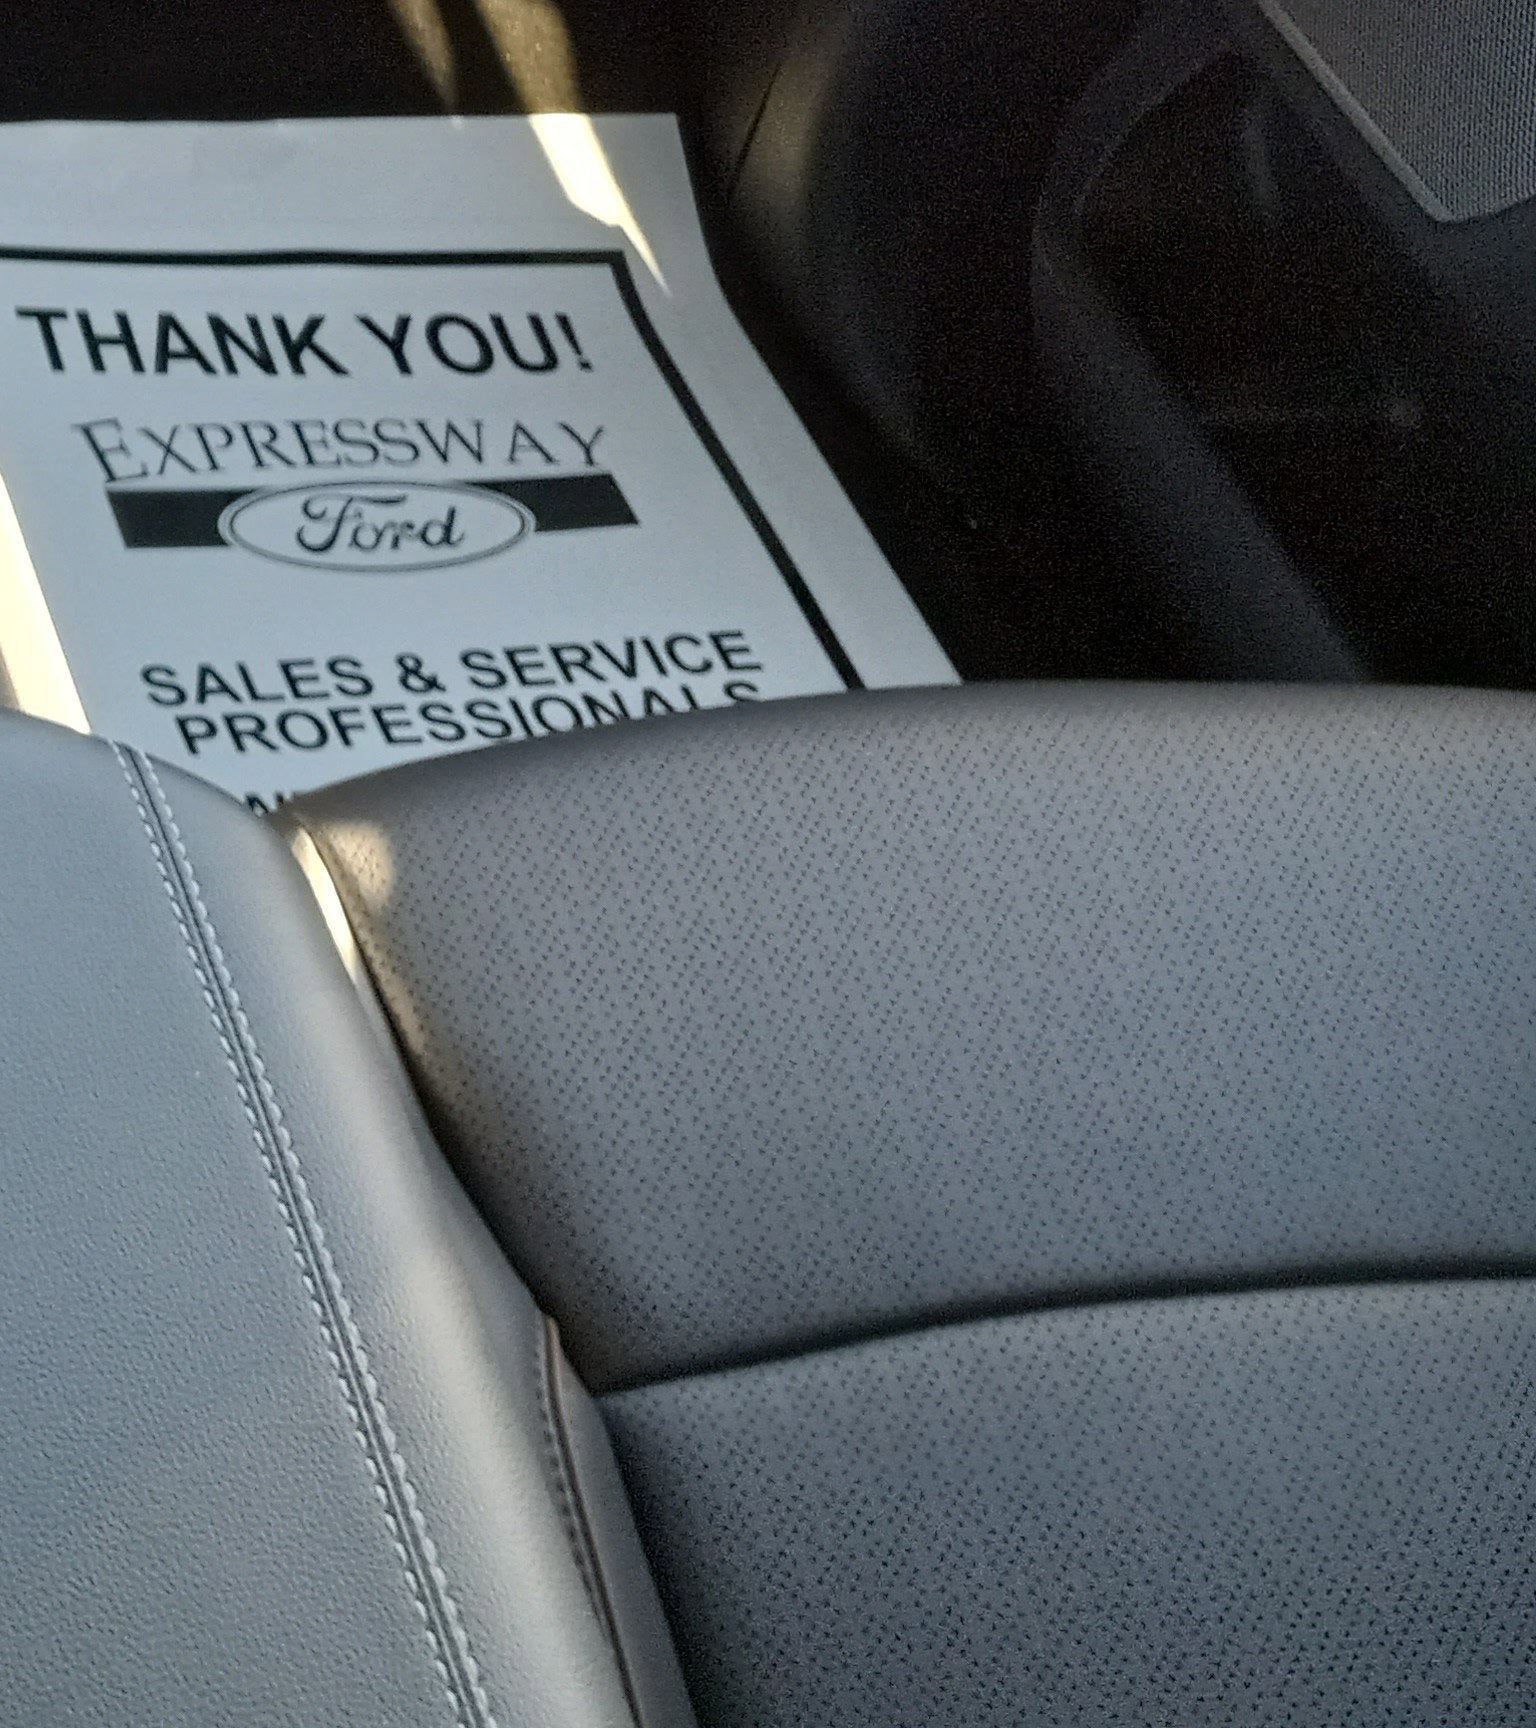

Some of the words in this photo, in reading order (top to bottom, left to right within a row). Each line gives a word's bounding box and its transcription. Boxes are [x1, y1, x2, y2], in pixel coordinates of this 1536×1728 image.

[16, 307, 350, 376] THANK
[358, 311, 594, 376] YOU!
[294, 493, 466, 553] Ford
[140, 653, 375, 709] SALES
[398, 654, 447, 693] &
[457, 630, 763, 689] SERVICE
